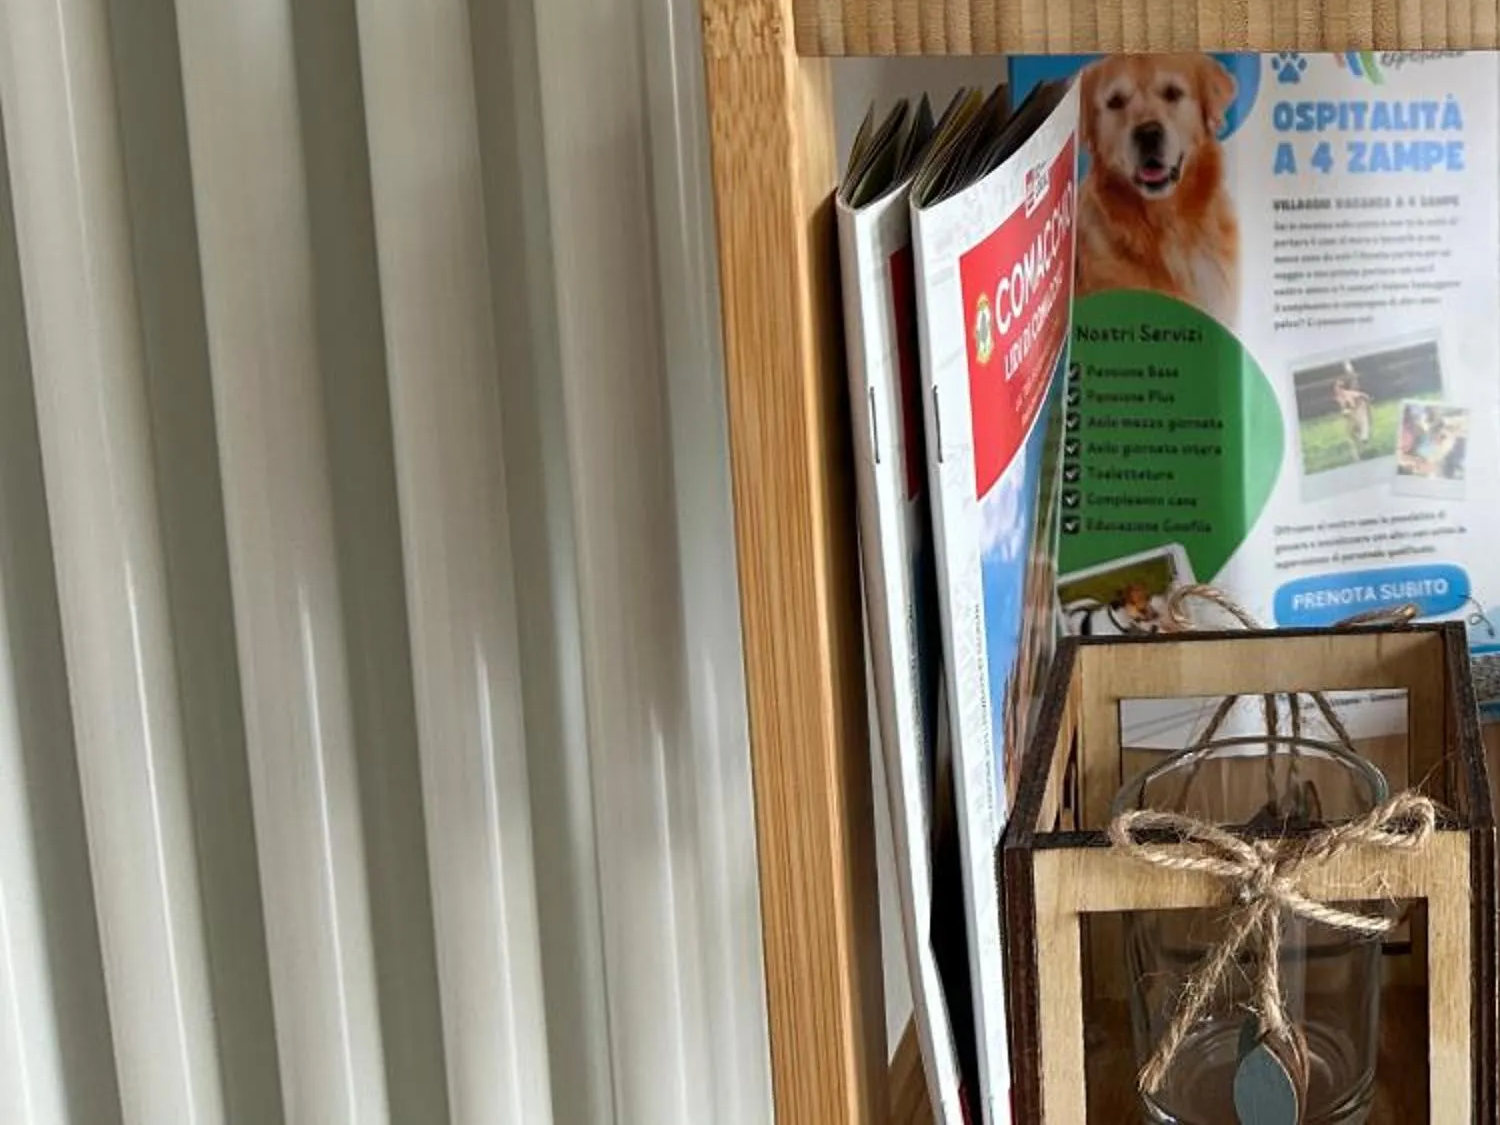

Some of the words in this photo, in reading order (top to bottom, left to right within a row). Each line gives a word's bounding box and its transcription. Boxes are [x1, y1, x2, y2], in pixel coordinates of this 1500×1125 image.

[1272, 93, 1463, 132] OSPITALITÀ
[1273, 142, 1297, 174] A
[1311, 141, 1333, 174] 4
[1346, 141, 1465, 173] ZAMPE
[1075, 324, 1135, 343] Nostri
[1139, 323, 1204, 343] Servizi
[1292, 586, 1375, 611] PRENOTA
[1378, 578, 1449, 603] SUBITO
